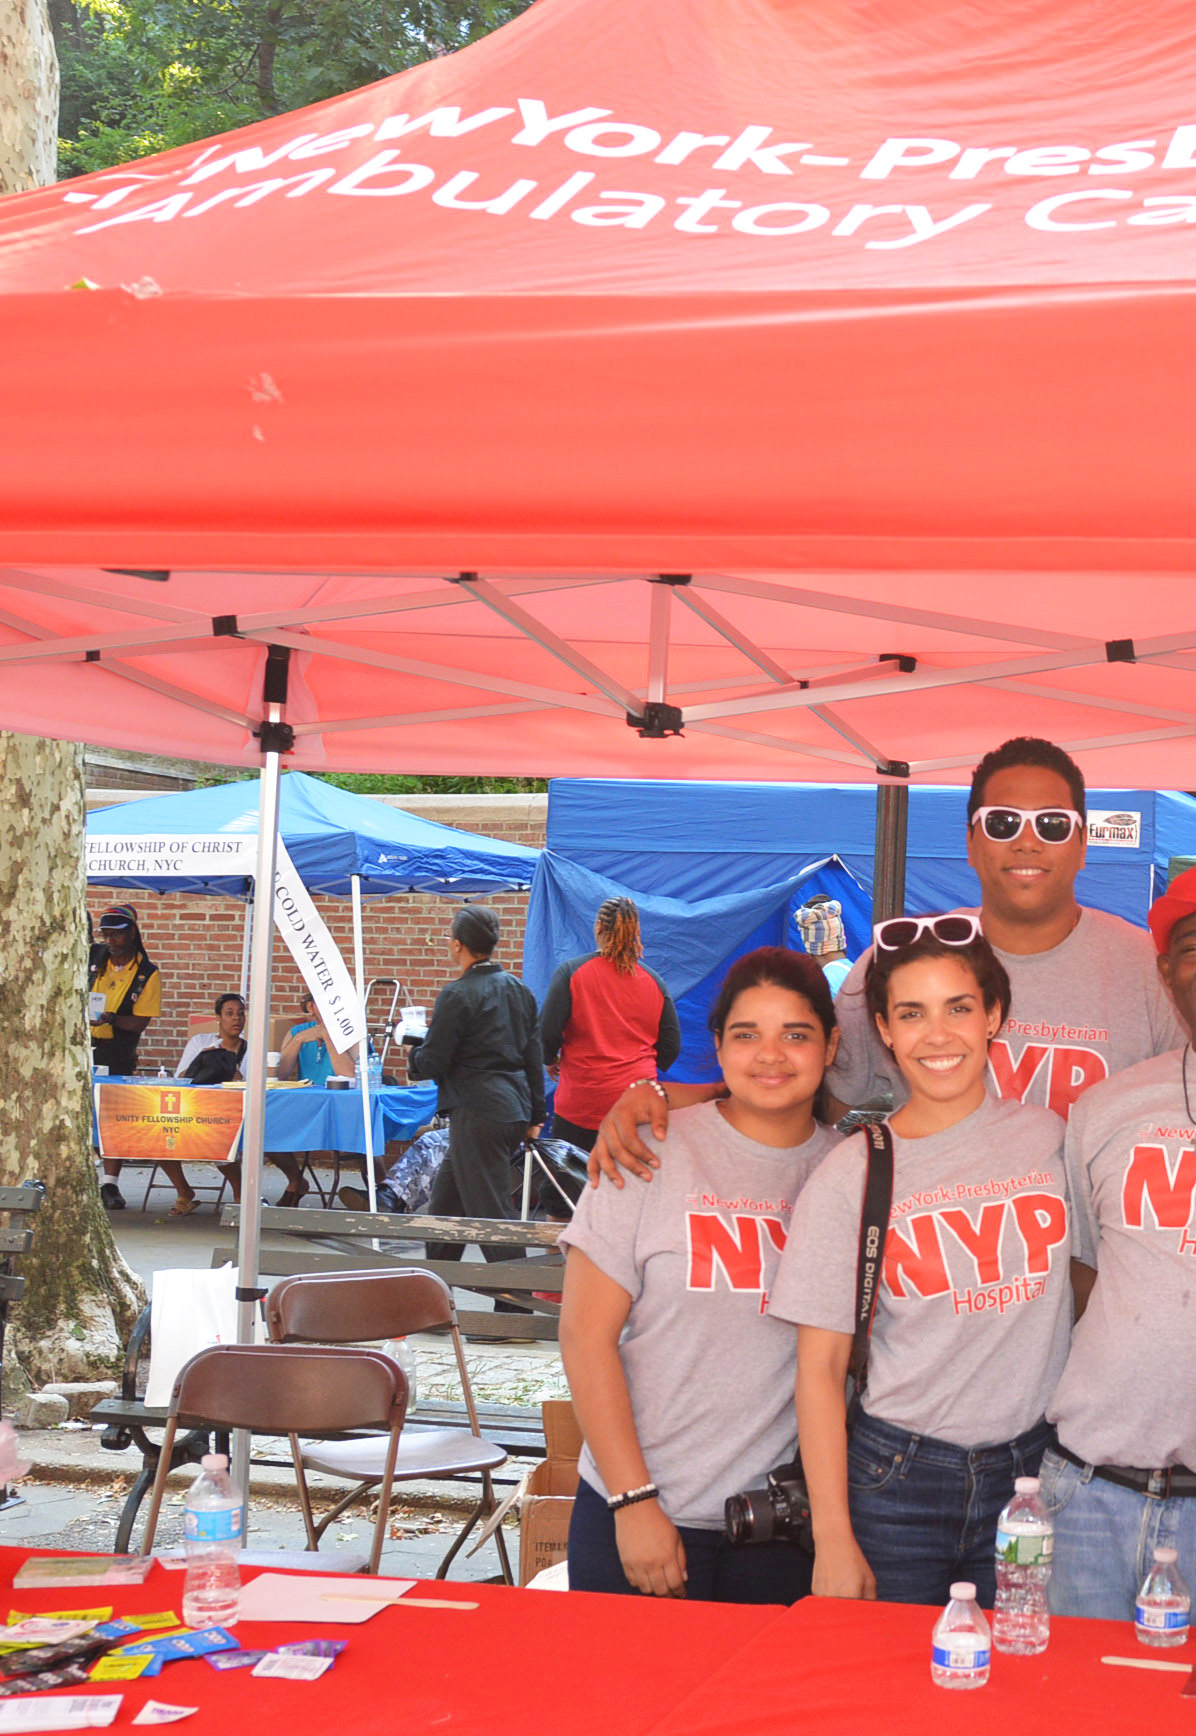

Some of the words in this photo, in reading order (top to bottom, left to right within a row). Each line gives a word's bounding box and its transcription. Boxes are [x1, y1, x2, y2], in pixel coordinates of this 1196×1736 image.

[72, 148, 994, 250] Ambulatory
[169, 841, 189, 853] OF
[191, 841, 243, 853] CHRIST
[1089, 823, 1135, 840] Eurmax
[88, 859, 150, 873] CHURCH,
[154, 859, 184, 871] NYC
[275, 886, 306, 932] COLD
[301, 934, 335, 991] WATER
[1001, 1018, 1109, 1042] -Presbyterian
[987, 1039, 1109, 1121] YP
[115, 1115, 139, 1123] UNITY
[142, 1115, 193, 1125] FELLOWSHIP
[196, 1117, 231, 1125] CHURCH
[163, 1126, 180, 1134] NYC
[889, 1169, 1056, 1221] ewYork-Presbyterian
[865, 1225, 880, 1259] EOS
[860, 1262, 876, 1321] DIGITAL
[951, 1276, 1048, 1316] Hospital
